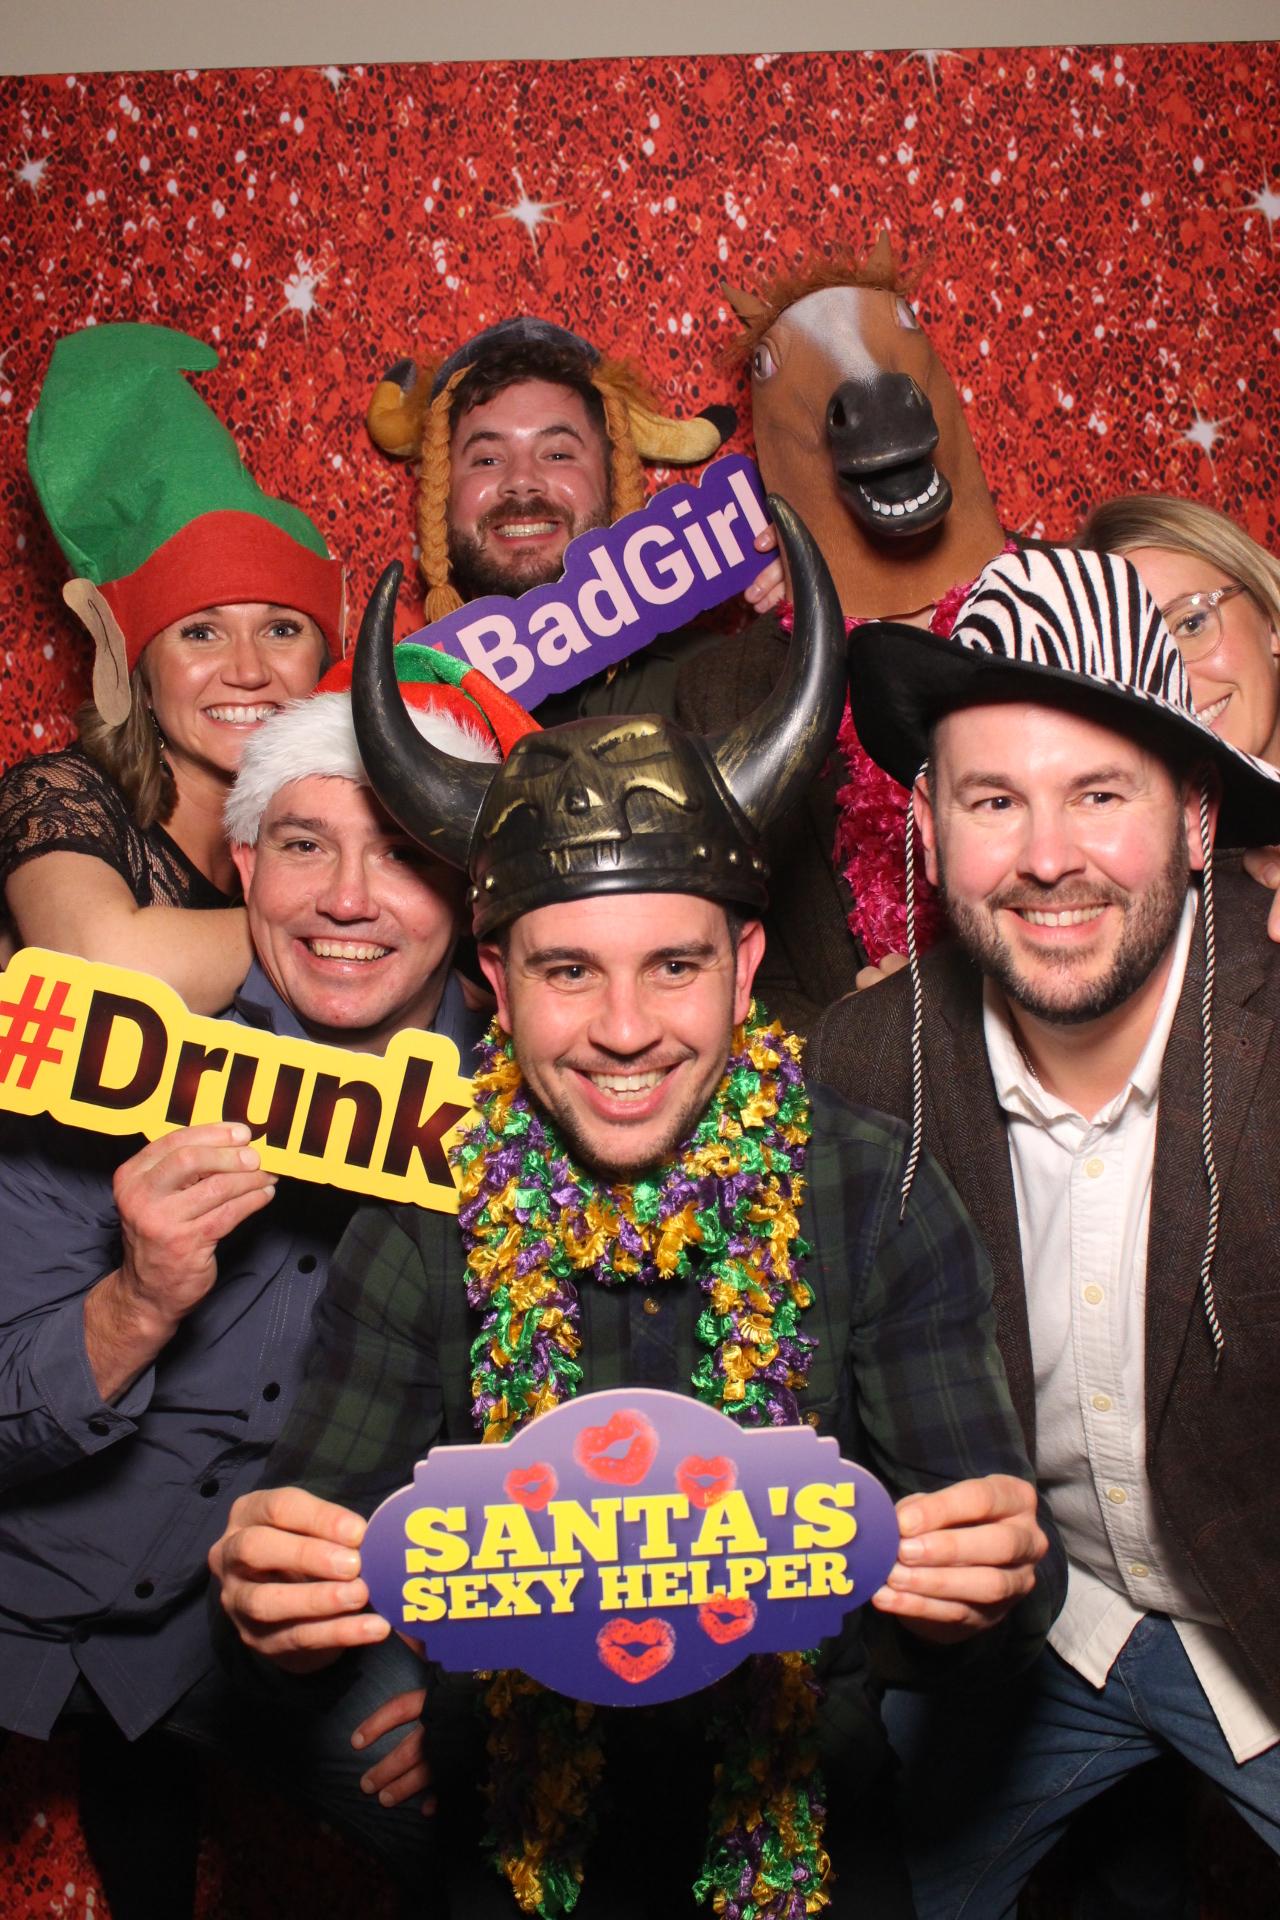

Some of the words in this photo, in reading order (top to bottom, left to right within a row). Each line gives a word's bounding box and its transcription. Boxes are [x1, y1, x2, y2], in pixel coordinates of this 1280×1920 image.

[432, 469, 770, 694] BadGirl
[0, 975, 471, 1189] #Drunk
[402, 1568, 584, 1622] SEXY
[599, 1552, 854, 1611] HELPER
[404, 1482, 858, 1574] SANTA'S
